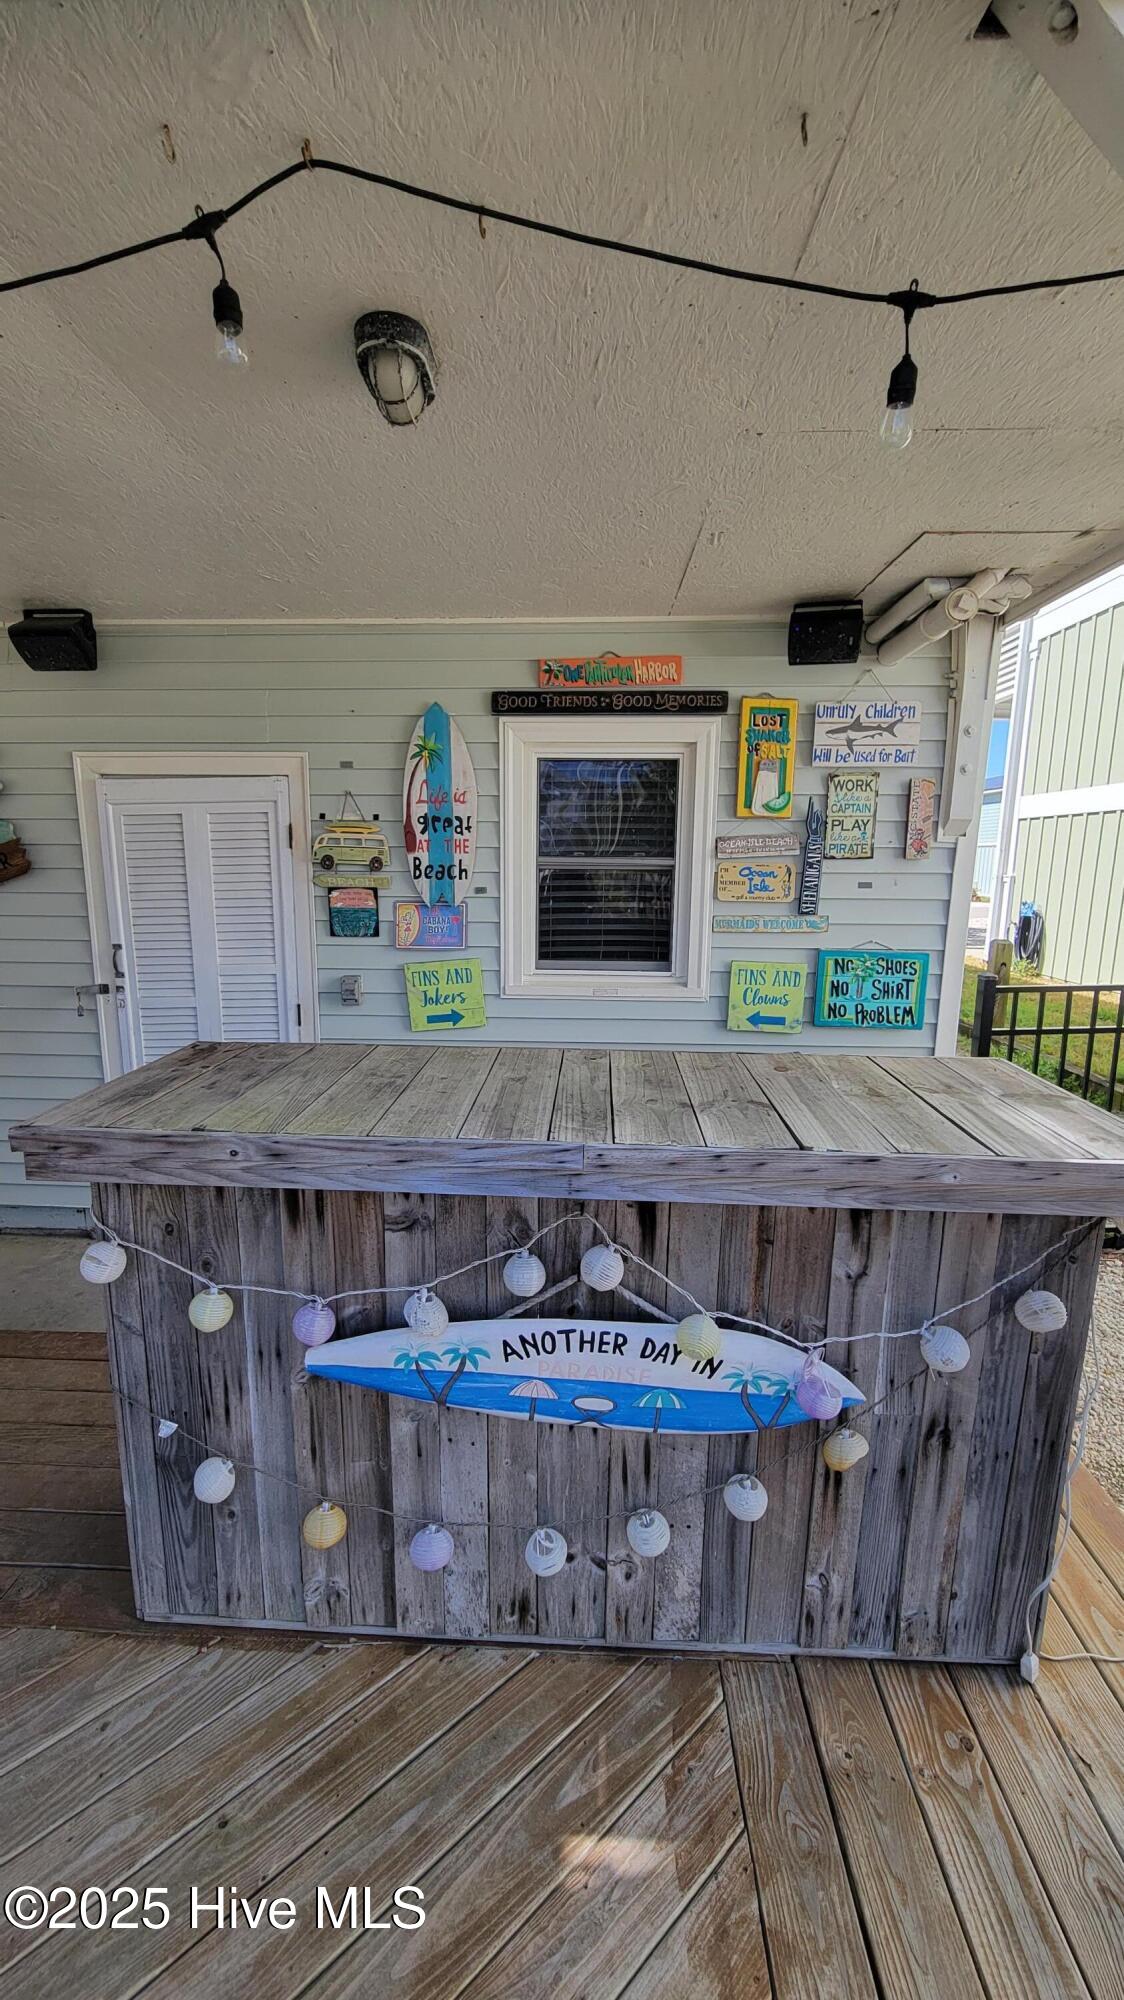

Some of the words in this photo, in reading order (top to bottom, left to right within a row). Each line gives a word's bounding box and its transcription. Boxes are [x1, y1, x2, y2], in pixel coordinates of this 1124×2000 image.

[563, 664, 584, 682] ONE
[634, 658, 677, 685] HARBOR
[498, 694, 537, 710] GOOD
[542, 694, 598, 708] FRIENDS
[612, 694, 651, 710] GOOD
[653, 694, 723, 710] MEMORIES
[817, 703, 857, 719] Unruly
[865, 702, 916, 719] Children
[752, 713, 787, 728] LOST
[760, 743, 791, 760] SALT
[813, 748, 832, 763] Will
[835, 748, 850, 763] be
[853, 748, 877, 763] used
[878, 748, 893, 763] for
[893, 748, 917, 763] Bait
[833, 779, 873, 792] WORK
[415, 778, 448, 811] Life
[454, 787, 467, 804] is
[831, 803, 871, 813] CAPTAIN
[417, 812, 472, 836] great
[831, 819, 871, 831] PLAY
[417, 839, 431, 853] AT
[444, 838, 469, 854] THE
[829, 843, 868, 855] PIRATE
[413, 856, 468, 880] Beach
[739, 866, 778, 879] Ocean
[328, 878, 374, 887] BEACH
[747, 878, 775, 894] Isle
[800, 843, 822, 914] SHENANIGANS
[423, 916, 451, 925] CABANA
[715, 919, 760, 929] MERMAIDS
[762, 919, 804, 929] WELCOME
[875, 957, 918, 976] SHOES
[411, 970, 440, 987] FINS
[446, 968, 473, 985] AND
[737, 969, 767, 985] FINS
[772, 970, 801, 987] AND
[743, 987, 791, 1006] Clowns
[831, 980, 849, 997] NO
[421, 987, 467, 1008] Jokers
[827, 1003, 847, 1019] NO
[502, 1328, 628, 1363] ANOTHER
[640, 1337, 683, 1366] DAY
[538, 1360, 652, 1384] PARADISE
